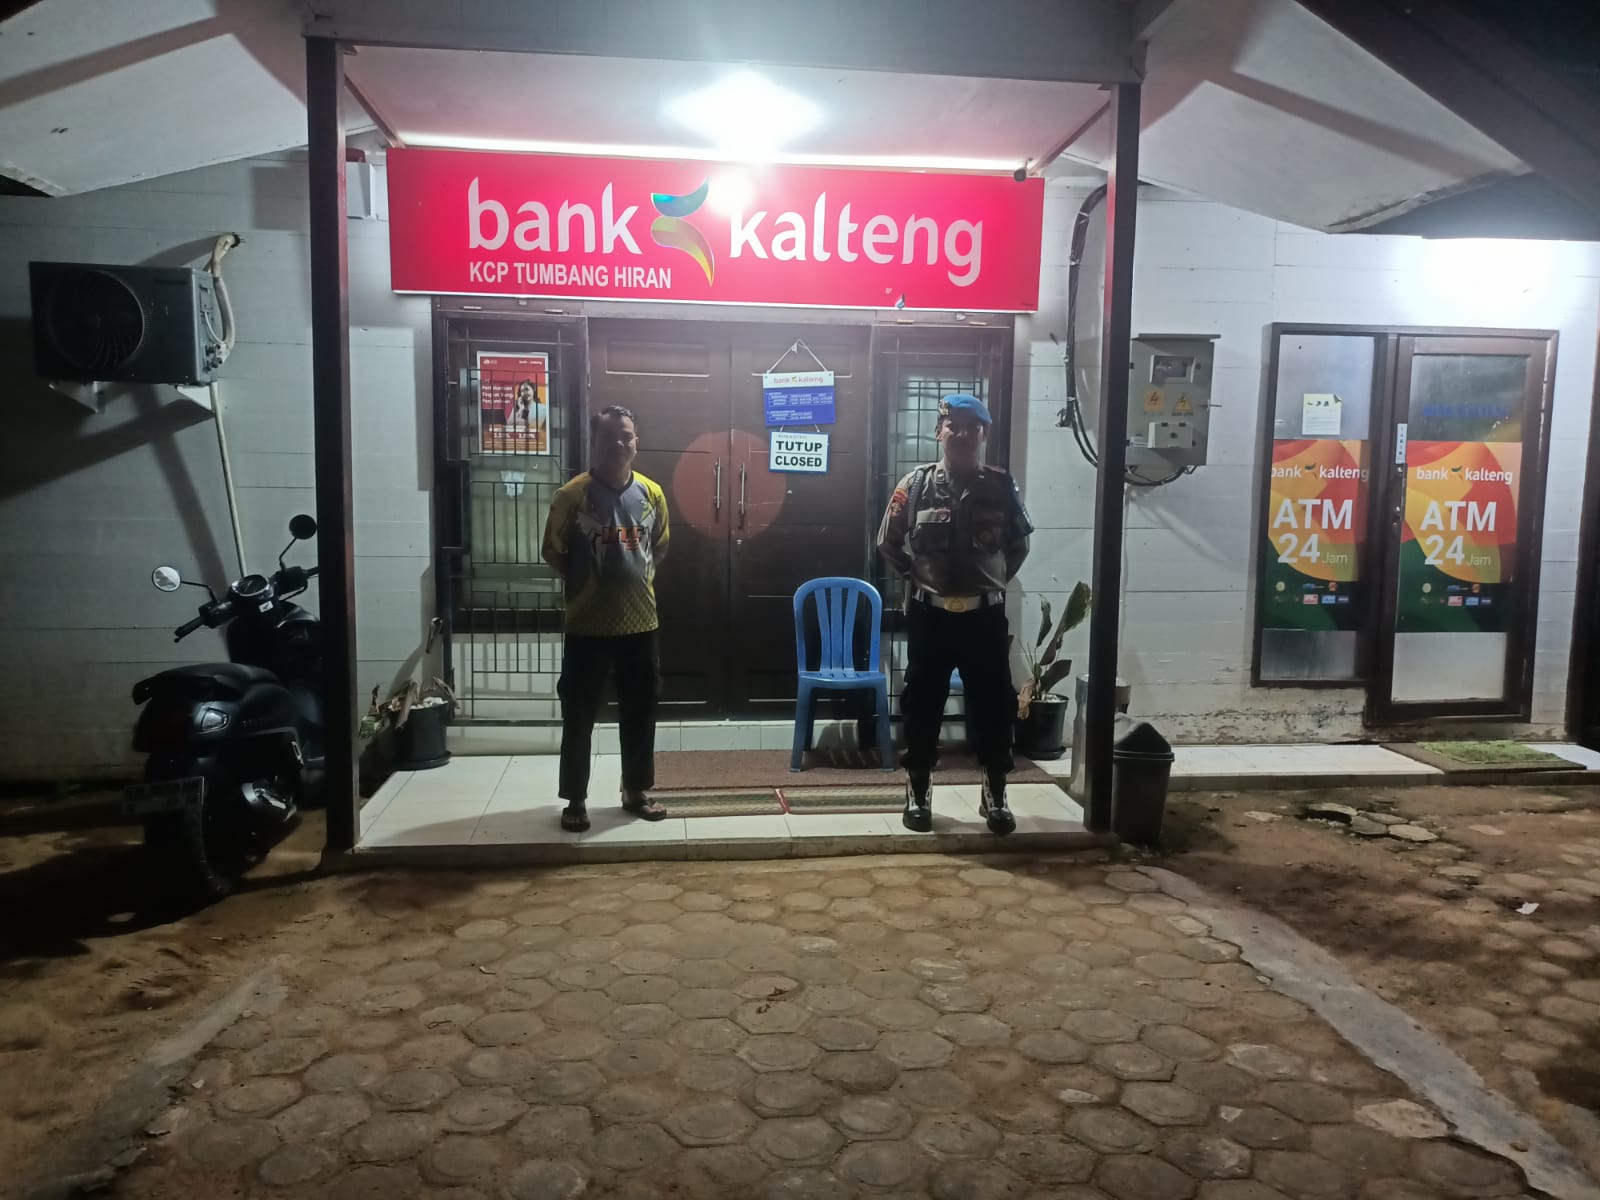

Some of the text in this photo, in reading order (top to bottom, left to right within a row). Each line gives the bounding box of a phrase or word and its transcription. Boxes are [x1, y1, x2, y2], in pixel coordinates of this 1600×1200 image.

[467, 176, 983, 287] bank kalteng
[469, 261, 671, 289] KCP TUMBANG HIRAN
[775, 455, 822, 467] CLOSED
[776, 441, 822, 452] TUTUP
[1319, 465, 1370, 482] kalteng
[1416, 466, 1513, 485] bank kalteng
[1272, 499, 1353, 530] ATM
[1420, 501, 1497, 532] ATM
[1277, 533, 1348, 564] 24 Jam
[1424, 534, 1492, 566] 24 Jam
